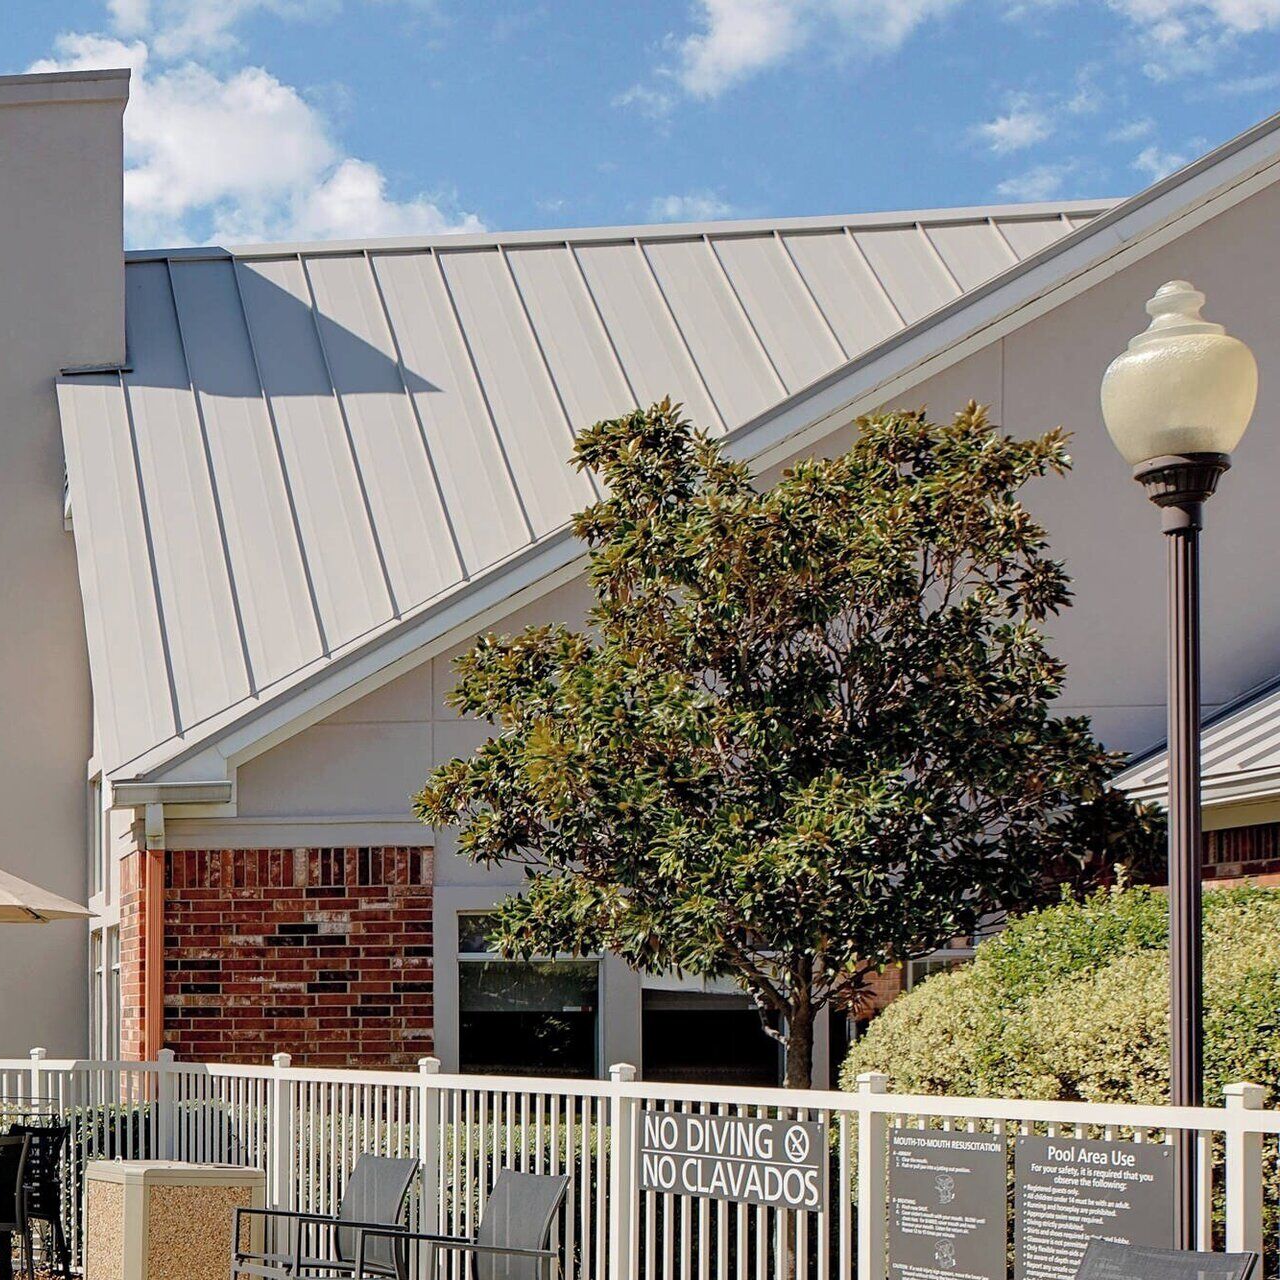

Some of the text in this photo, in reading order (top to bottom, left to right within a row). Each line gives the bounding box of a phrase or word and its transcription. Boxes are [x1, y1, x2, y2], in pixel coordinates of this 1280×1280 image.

[644, 1115, 773, 1159] NO DIVING
[894, 1137, 1001, 1152] MOUTH-TO-MOUTH RESUSCITATION
[1048, 1146, 1135, 1166] Pool Area Use
[643, 1154, 818, 1206] NO CLAVADOS
[1031, 1163, 1042, 1172] For
[1042, 1166, 1057, 1174] your
[1058, 1166, 1080, 1177] safety,
[1093, 1169, 1122, 1180] required
[1123, 1171, 1138, 1180] that
[1139, 1173, 1154, 1182] you
[1054, 1176, 1079, 1186] observe
[1080, 1177, 1091, 1187] the
